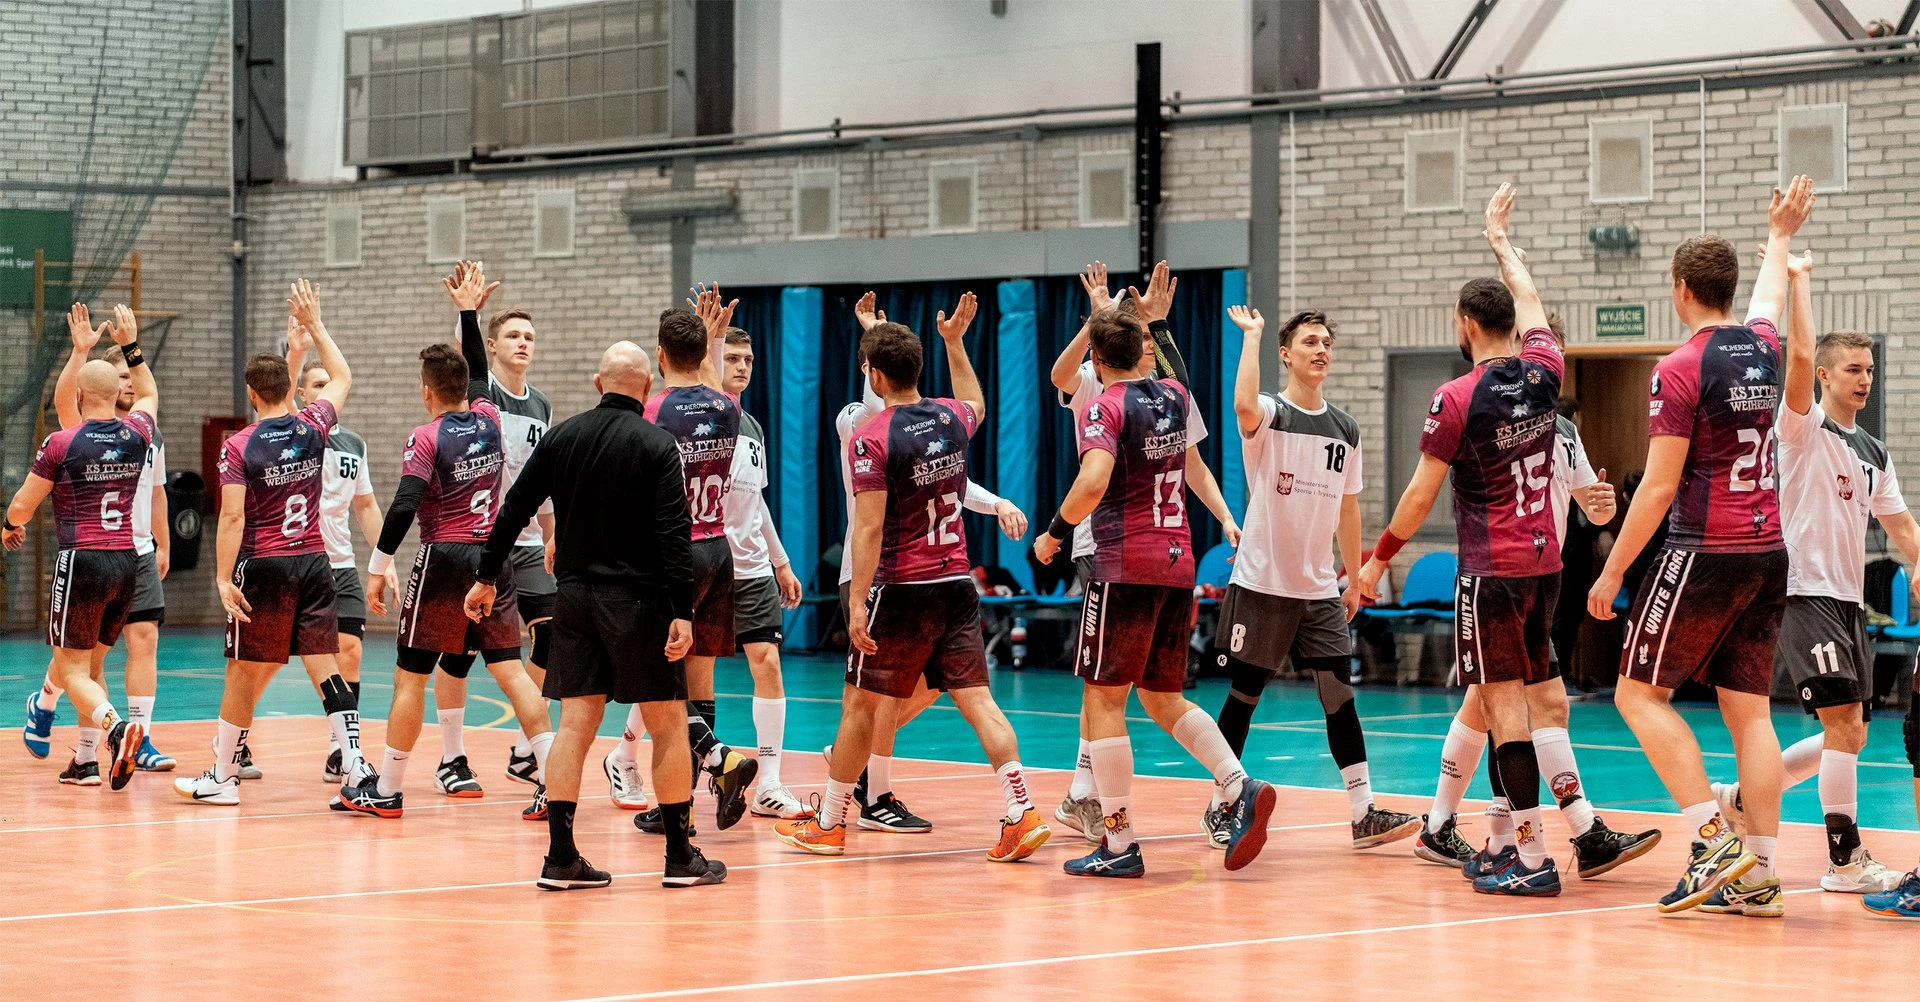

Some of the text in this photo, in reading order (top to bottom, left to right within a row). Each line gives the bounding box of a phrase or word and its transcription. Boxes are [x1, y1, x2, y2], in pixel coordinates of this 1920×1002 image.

[1729, 386, 1746, 400] KS
[526, 424, 543, 447] 41
[1144, 436, 1158, 450] KS
[1495, 410, 1555, 441] KS TYTANI
[680, 438, 734, 454] KS TYTANI
[912, 450, 963, 477] KS TYTANI
[1324, 442, 1346, 473] 18
[1729, 427, 1775, 492] 20
[86, 462, 140, 473] KS TYTANI
[264, 457, 321, 479] KS TYTANI
[339, 456, 358, 480] 55
[453, 461, 468, 473] KS
[1510, 450, 1549, 518] 15
[100, 491, 124, 531] 6
[281, 493, 309, 538] 8
[470, 489, 492, 525] 9
[688, 474, 724, 524] 10
[1152, 469, 1184, 528] 13
[925, 491, 963, 546] 12
[54, 551, 70, 613] WHITE HAR
[404, 543, 427, 609] WHITE HAR
[1085, 590, 1099, 637] WHITE
[1461, 594, 1473, 641] WHITE
[1645, 587, 1671, 635] WHITE
[1230, 623, 1246, 652] 8
[1810, 641, 1839, 675] 11
